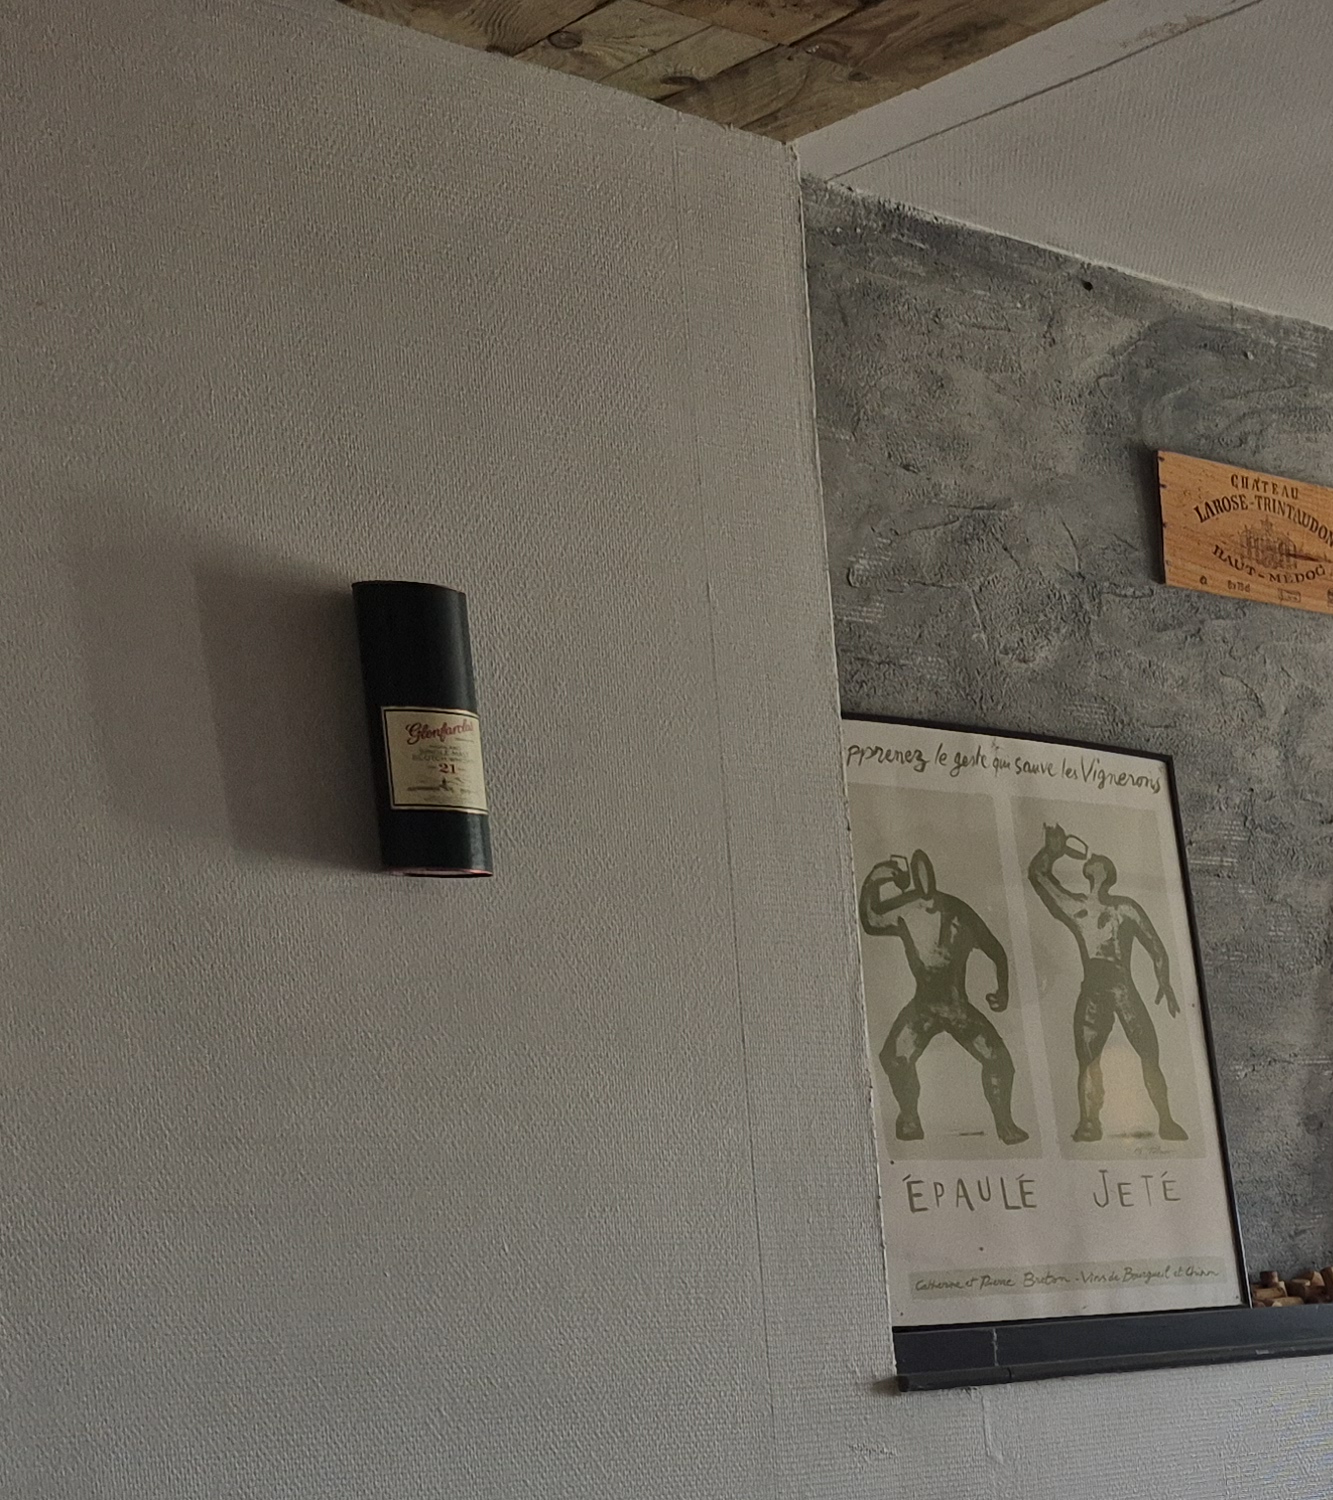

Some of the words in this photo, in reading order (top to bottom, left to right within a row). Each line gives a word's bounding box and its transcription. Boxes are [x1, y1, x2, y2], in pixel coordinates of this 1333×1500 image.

[847, 744, 929, 772] pprenez
[935, 743, 947, 766] le
[950, 745, 988, 777] geste
[993, 754, 1010, 776] qui
[1015, 756, 1056, 777] sauve
[1062, 758, 1078, 780] les
[1081, 756, 1161, 794] Vignerons
[902, 1173, 1038, 1213] ÉPAULÉ
[1093, 1169, 1182, 1209] JETÉ
